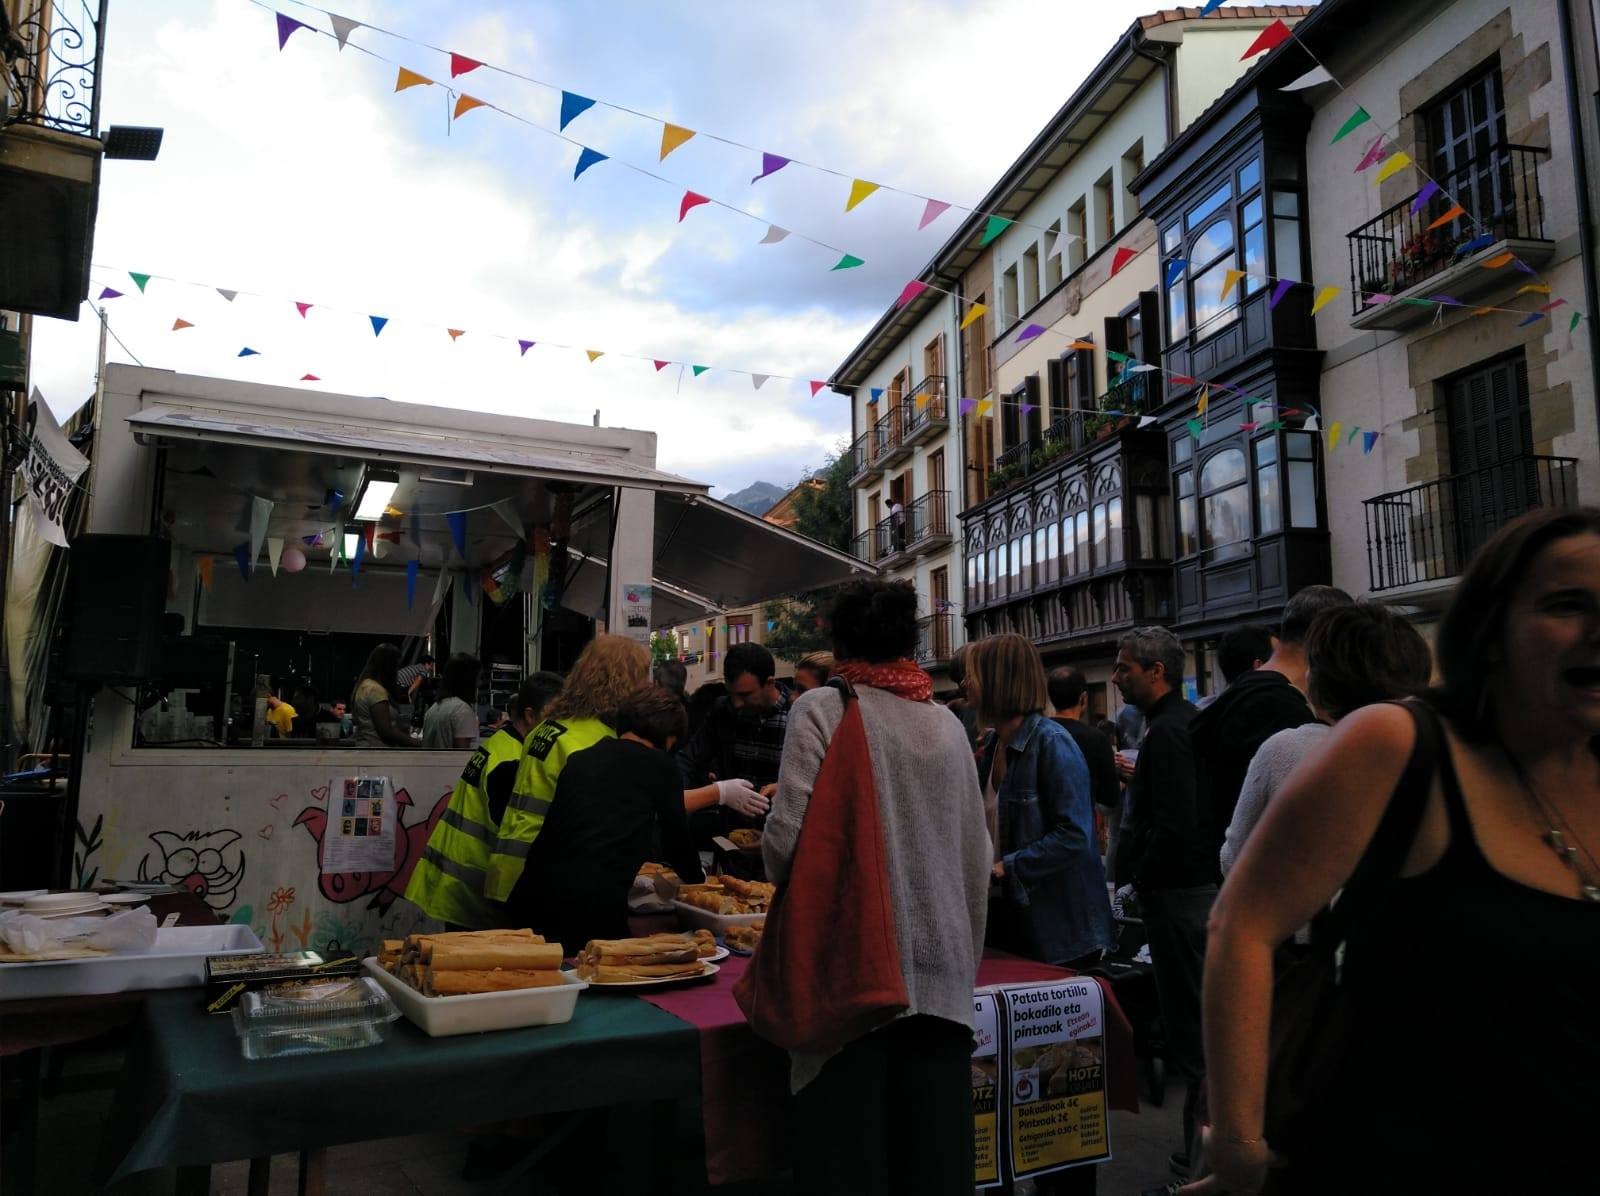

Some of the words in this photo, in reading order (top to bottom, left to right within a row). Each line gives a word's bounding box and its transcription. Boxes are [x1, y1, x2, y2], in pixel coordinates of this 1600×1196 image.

[1011, 991, 1049, 1005] Patata
[1051, 985, 1087, 1000] tortilla
[1014, 1005, 1062, 1022] bokadilo
[1064, 1003, 1081, 1015] eta
[1014, 1020, 1063, 1041] pintxoak
[1069, 1066, 1101, 1082] HOTZ
